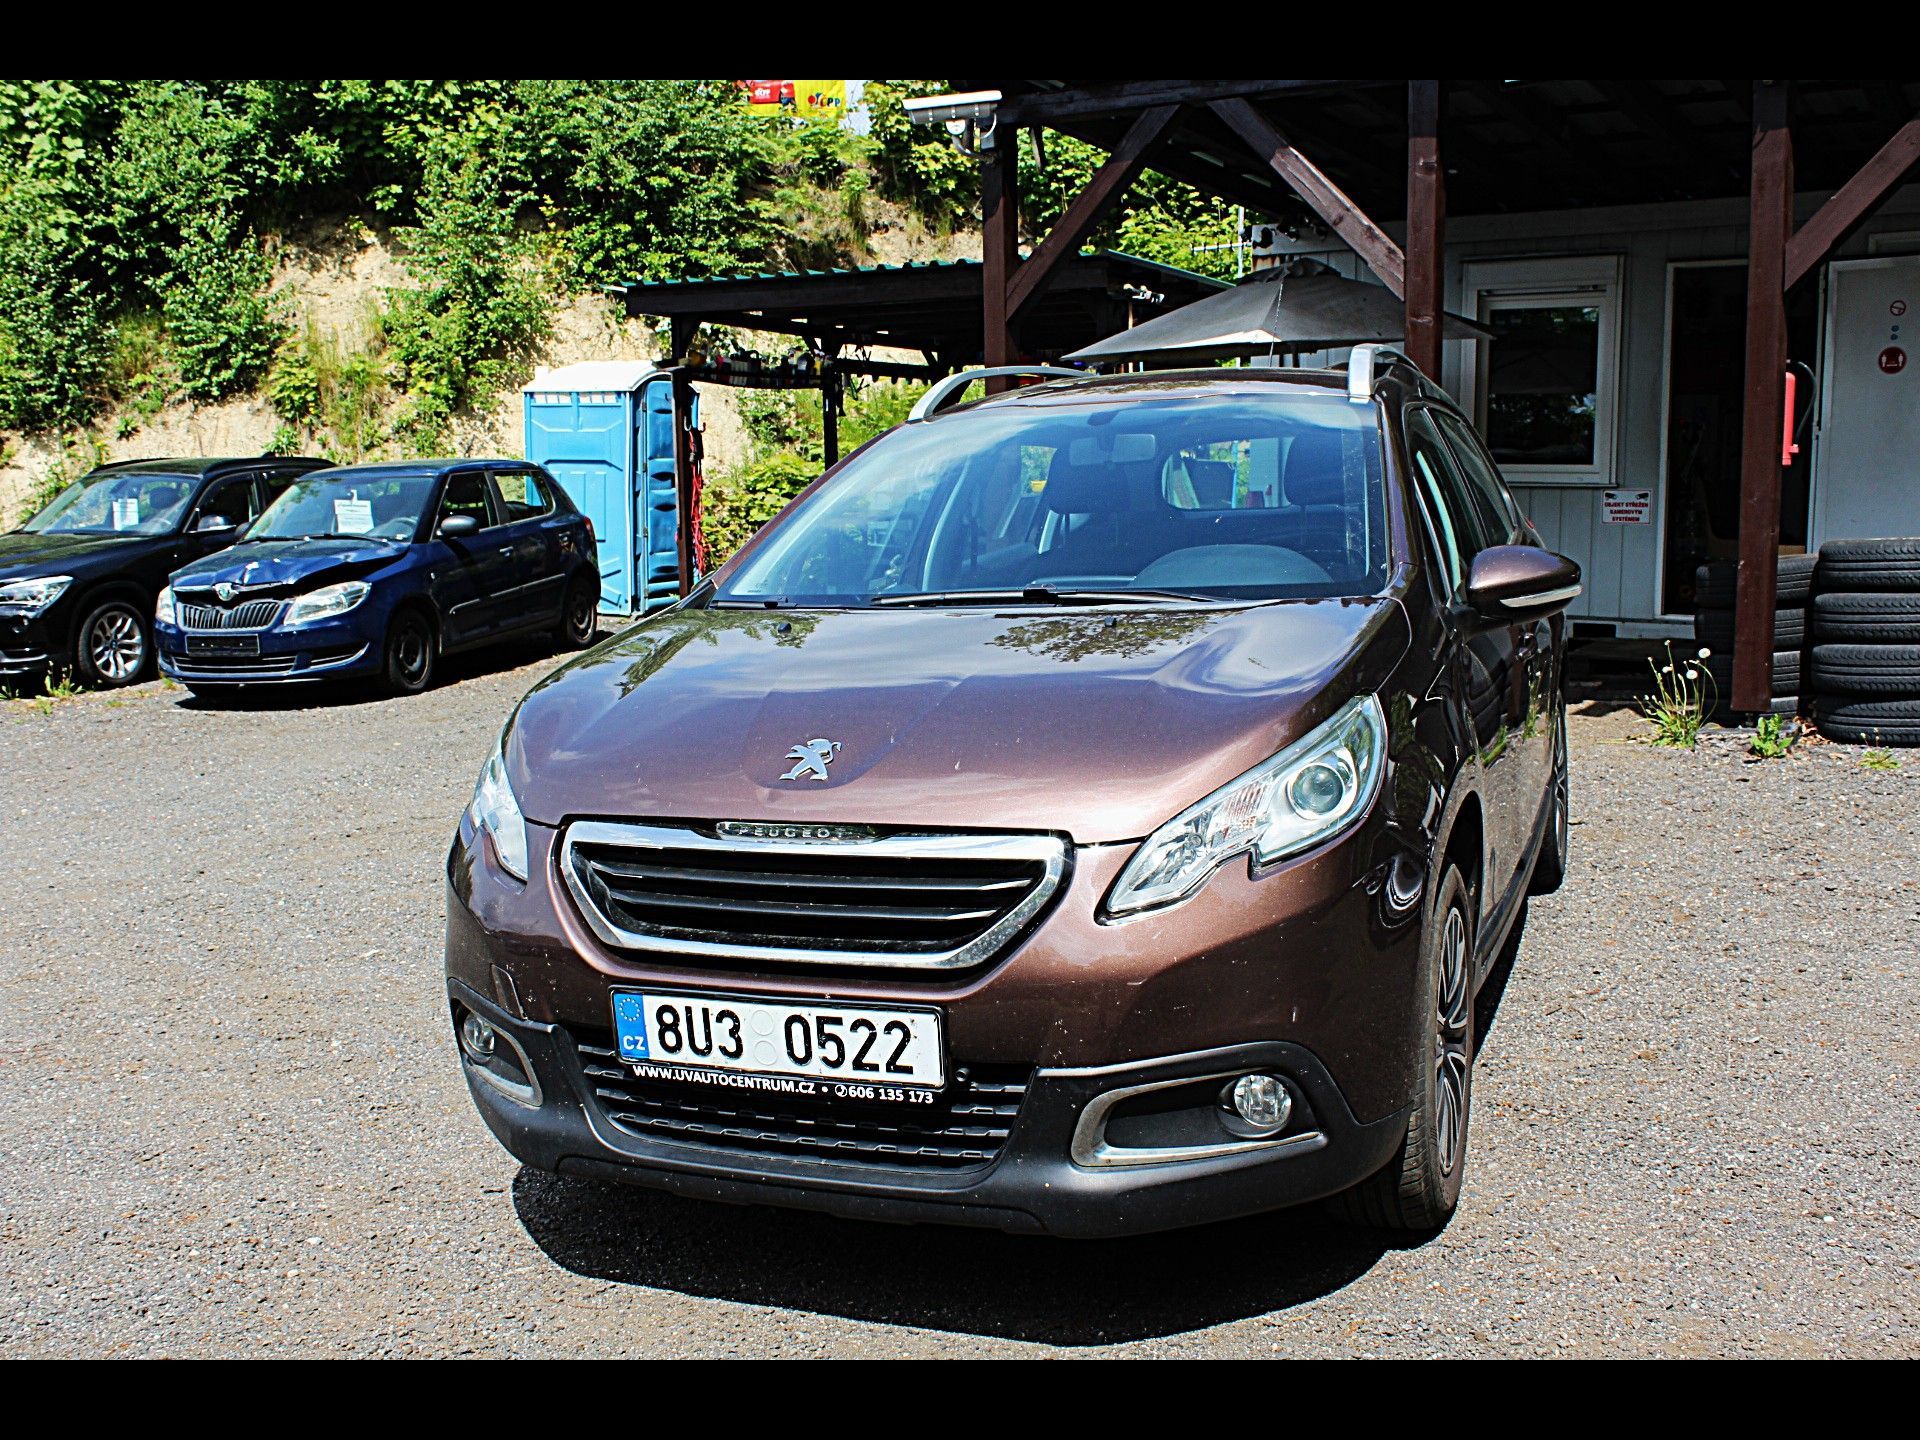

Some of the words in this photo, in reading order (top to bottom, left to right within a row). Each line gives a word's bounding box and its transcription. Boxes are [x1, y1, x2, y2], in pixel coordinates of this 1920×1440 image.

[738, 824, 846, 838] PEUGEOT
[622, 1034, 646, 1051] CZ
[655, 1004, 744, 1060] 8U3
[783, 1014, 914, 1075] 0522
[632, 1064, 816, 1095] WWW.UVAUTOCENTRUM.CZ
[848, 1085, 875, 1099] 606
[878, 1088, 905, 1101] 135
[908, 1090, 934, 1104] 173
